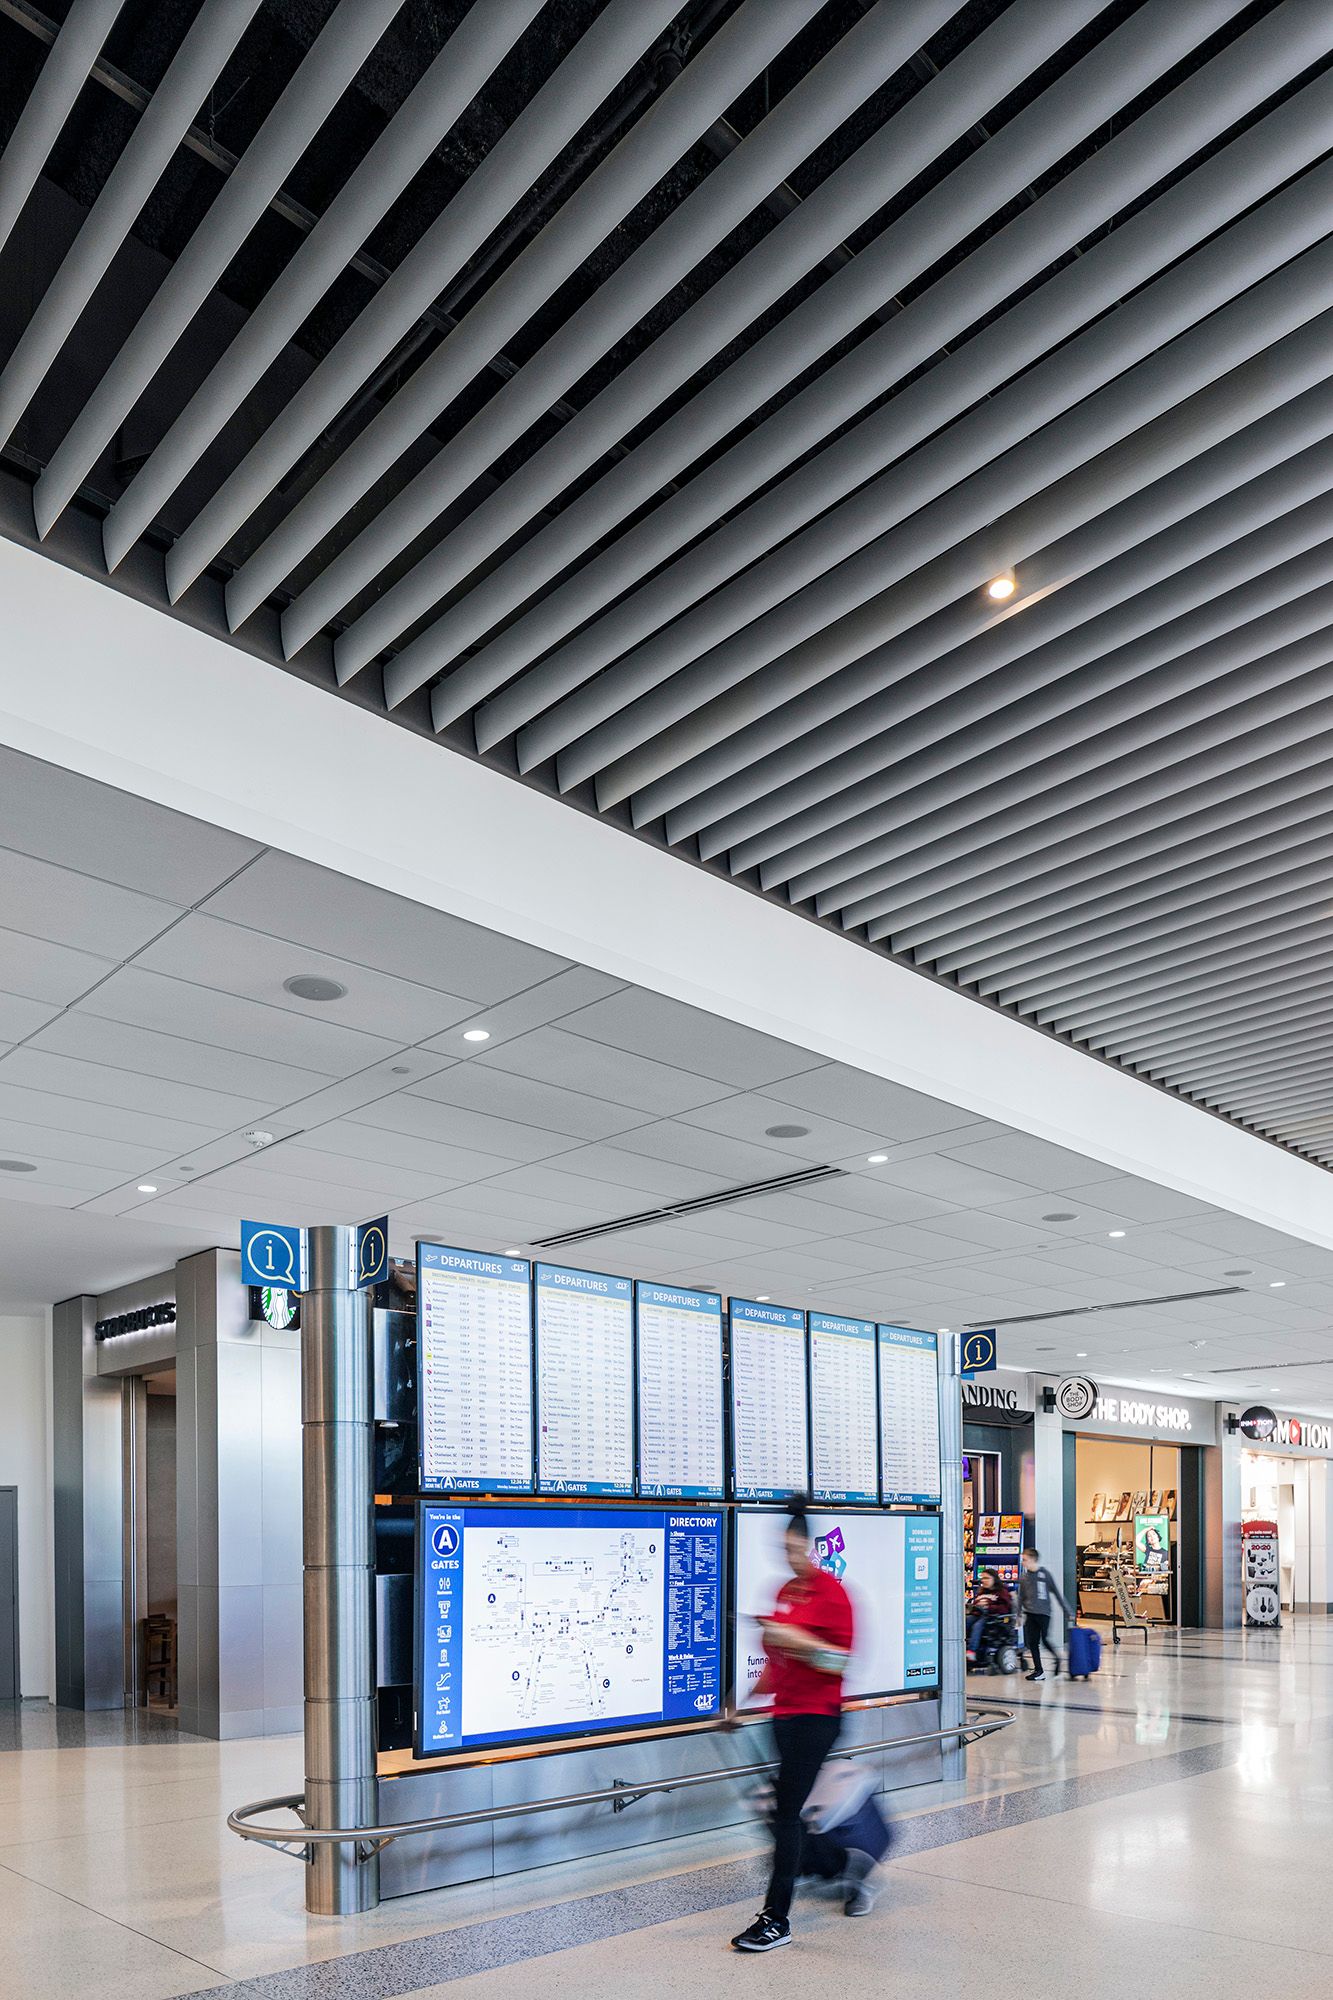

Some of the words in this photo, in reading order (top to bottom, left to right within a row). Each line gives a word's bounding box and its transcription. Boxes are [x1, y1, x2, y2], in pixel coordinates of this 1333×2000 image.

[440, 1255, 502, 1274] DEPARTURES
[554, 1274, 608, 1292] DEPARTURES
[653, 1292, 700, 1307] DEPARTURES
[95, 1302, 176, 1341] STARBUCKS
[745, 1308, 786, 1322] DEPARTURES
[822, 1320, 859, 1333] DEPARTURES
[889, 1332, 922, 1344] DEPARTURES
[1121, 1400, 1155, 1426] BODY
[457, 1480, 479, 1488] GATES
[568, 1483, 587, 1491] GATES
[757, 1490, 773, 1498] GATES
[669, 1517, 717, 1527] DIRECTORY
[437, 1529, 454, 1549] A
[431, 1560, 459, 1569] GATES
[1122, 1603, 1133, 1620] SHOP
[747, 1656, 769, 1666] funne
[747, 1669, 762, 1679] into
